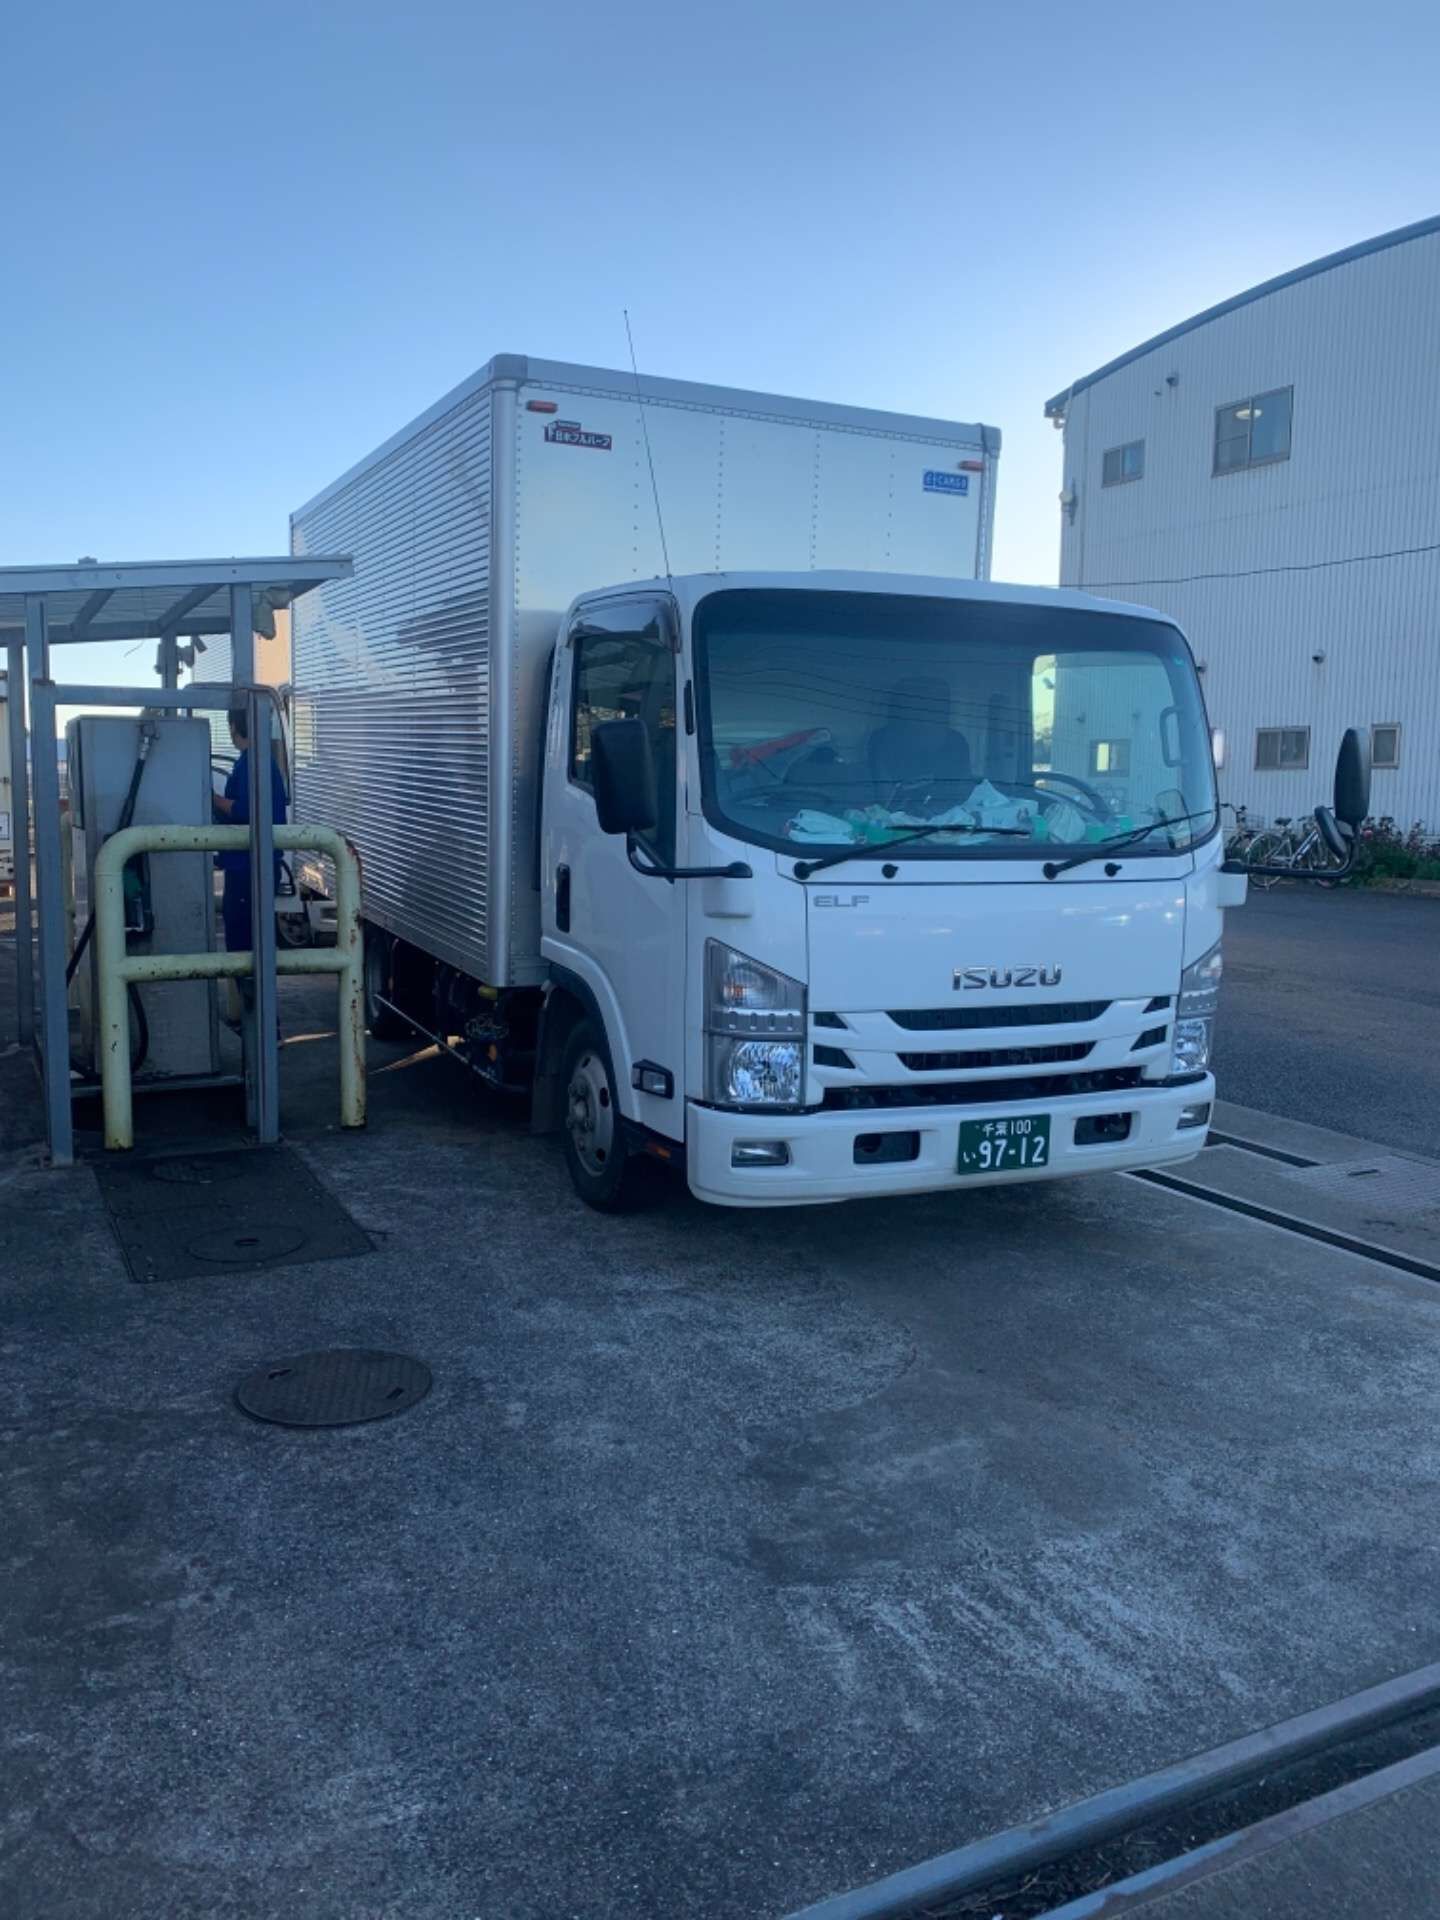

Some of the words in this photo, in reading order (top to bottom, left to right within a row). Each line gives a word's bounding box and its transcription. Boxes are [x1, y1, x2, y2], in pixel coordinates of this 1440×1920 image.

[813, 895, 870, 907] ELF
[952, 964, 1062, 991] ISUZU
[982, 1121, 1008, 1137] 千葉
[1010, 1119, 1031, 1135] 100
[963, 1151, 977, 1163] い
[979, 1136, 1045, 1168] 97-12
